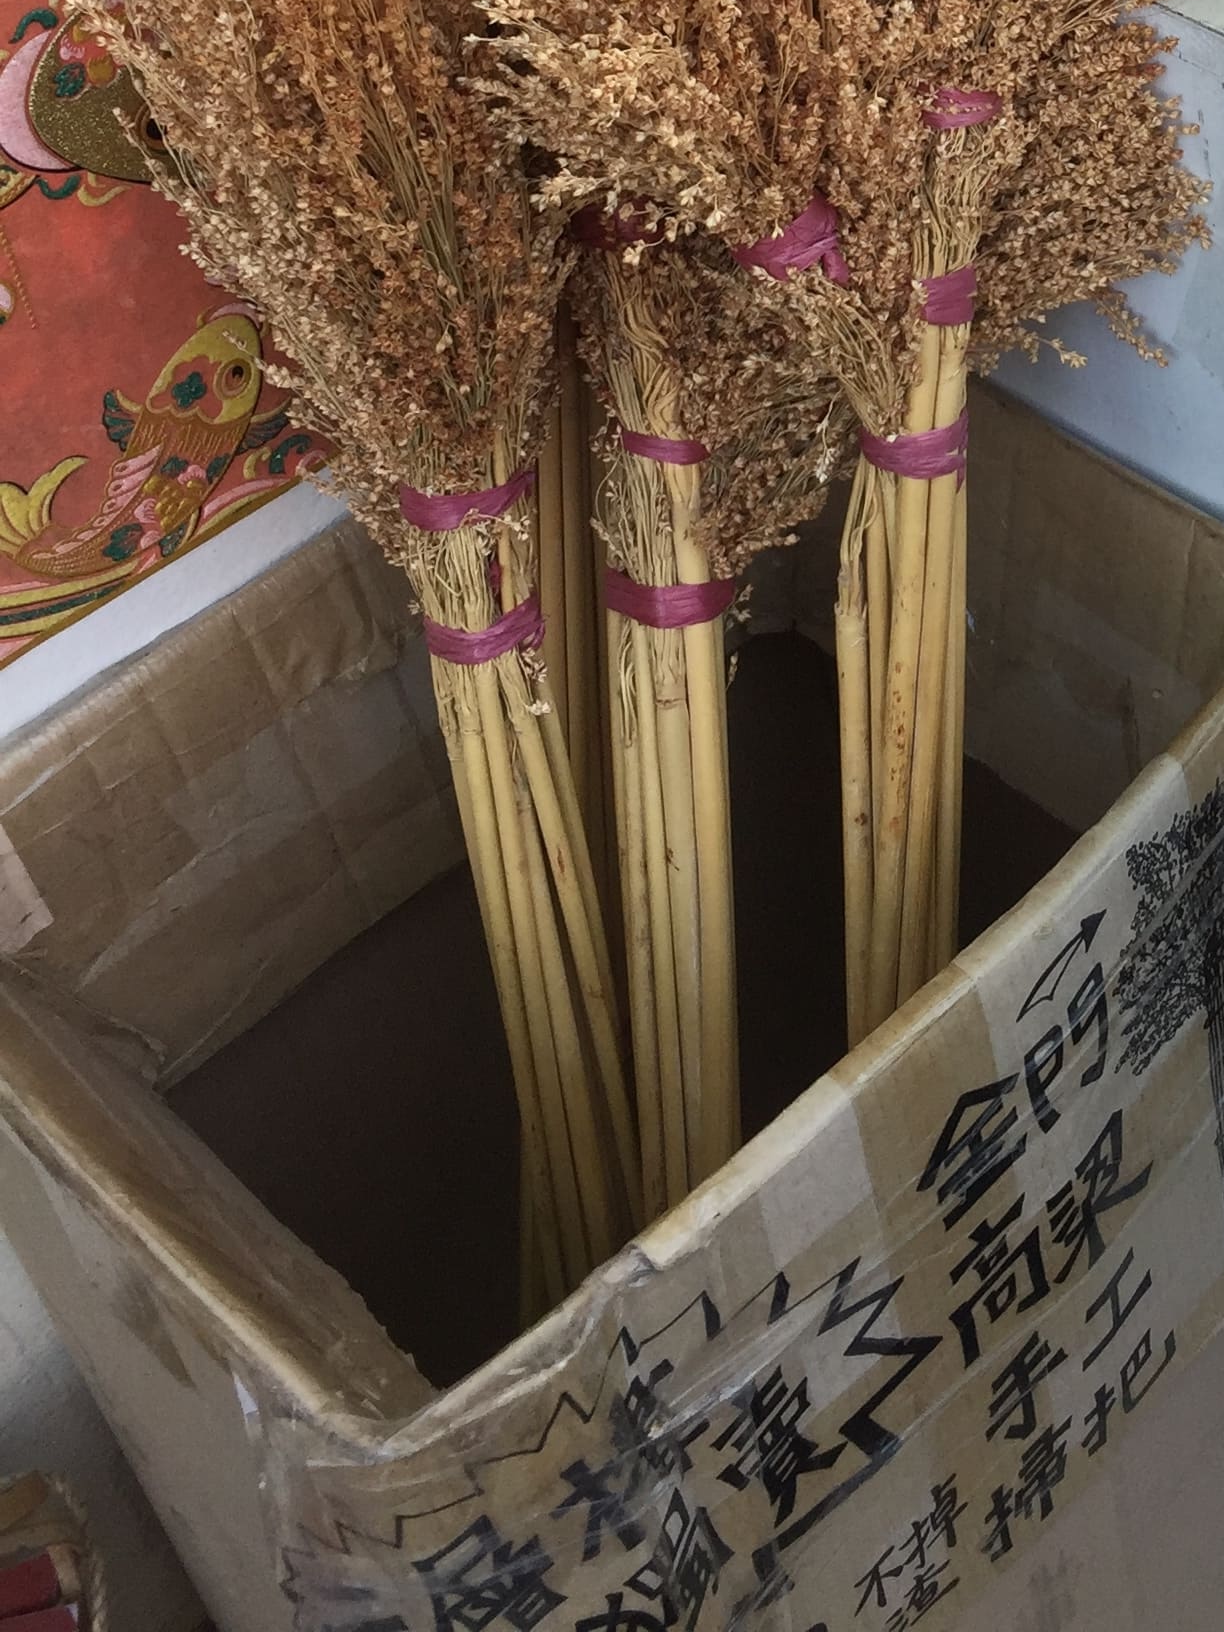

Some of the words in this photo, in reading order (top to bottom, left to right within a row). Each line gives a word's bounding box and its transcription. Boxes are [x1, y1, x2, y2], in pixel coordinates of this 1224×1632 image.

[916, 961, 1109, 1231] 金門
[981, 1328, 1175, 1562] 掃把
[985, 1246, 1152, 1442] 手工
